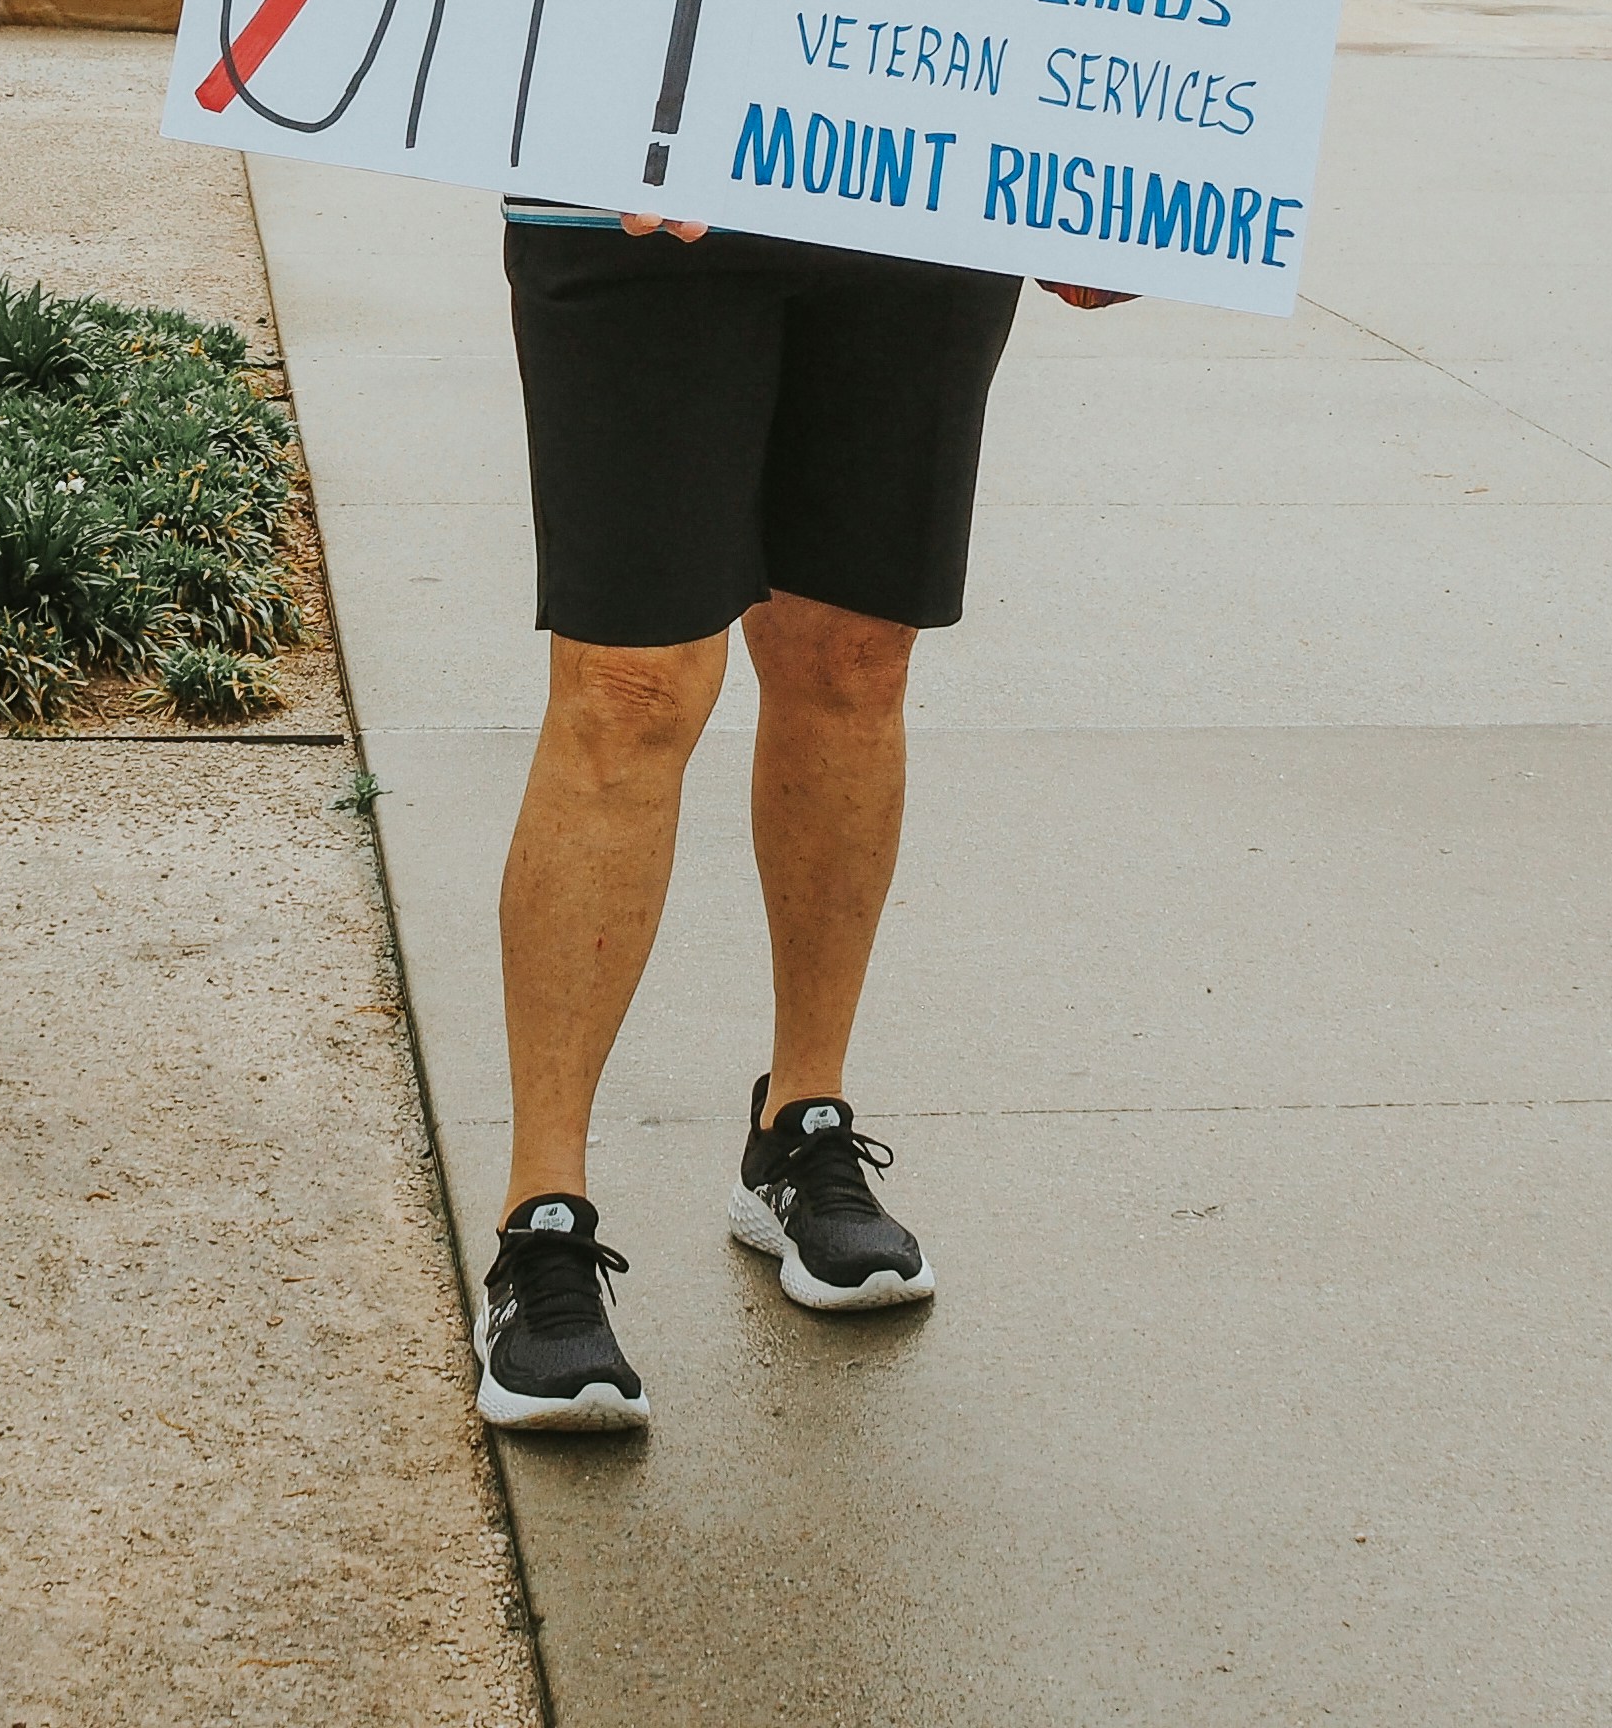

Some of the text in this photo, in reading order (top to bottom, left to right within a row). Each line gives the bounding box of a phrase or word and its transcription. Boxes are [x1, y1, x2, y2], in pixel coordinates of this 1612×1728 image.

[796, 12, 1258, 137] VETERAN SERVICES
[730, 102, 1305, 270] MOUNT RUSHMORE
